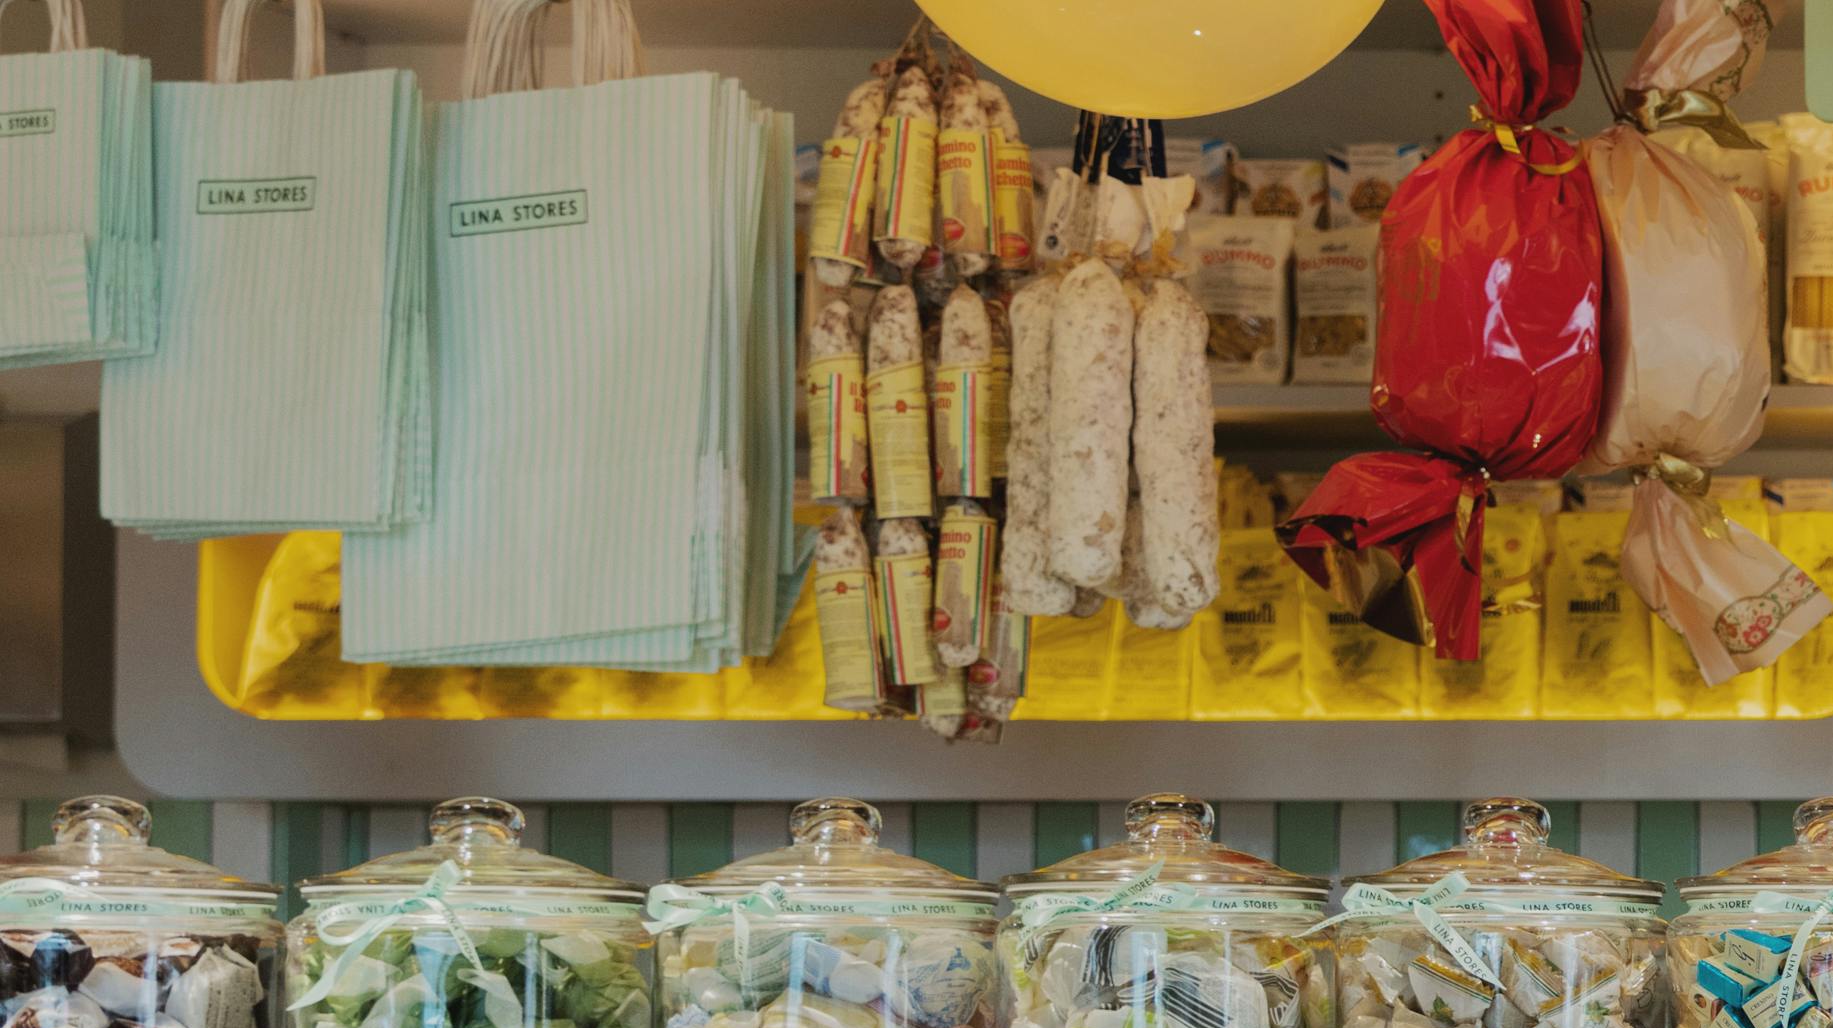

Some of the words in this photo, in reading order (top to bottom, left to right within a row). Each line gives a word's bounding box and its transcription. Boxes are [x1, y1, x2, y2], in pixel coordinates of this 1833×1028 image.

[8, 115, 50, 130] STORES
[207, 187, 246, 206] LINA
[254, 185, 308, 203] STORES
[459, 207, 504, 227] LINA
[513, 198, 578, 222] STORES
[60, 902, 93, 913] LINA
[99, 902, 148, 913] STORES
[891, 904, 918, 913] LINA
[923, 905, 956, 914] STORES
[1212, 900, 1239, 910] LINA
[1241, 900, 1280, 910] STORES
[1522, 902, 1550, 912] LINA
[1554, 902, 1593, 913] STORES
[1433, 922, 1458, 951] LINA
[1454, 947, 1487, 984] STORES
[1784, 953, 1798, 981] LINA
